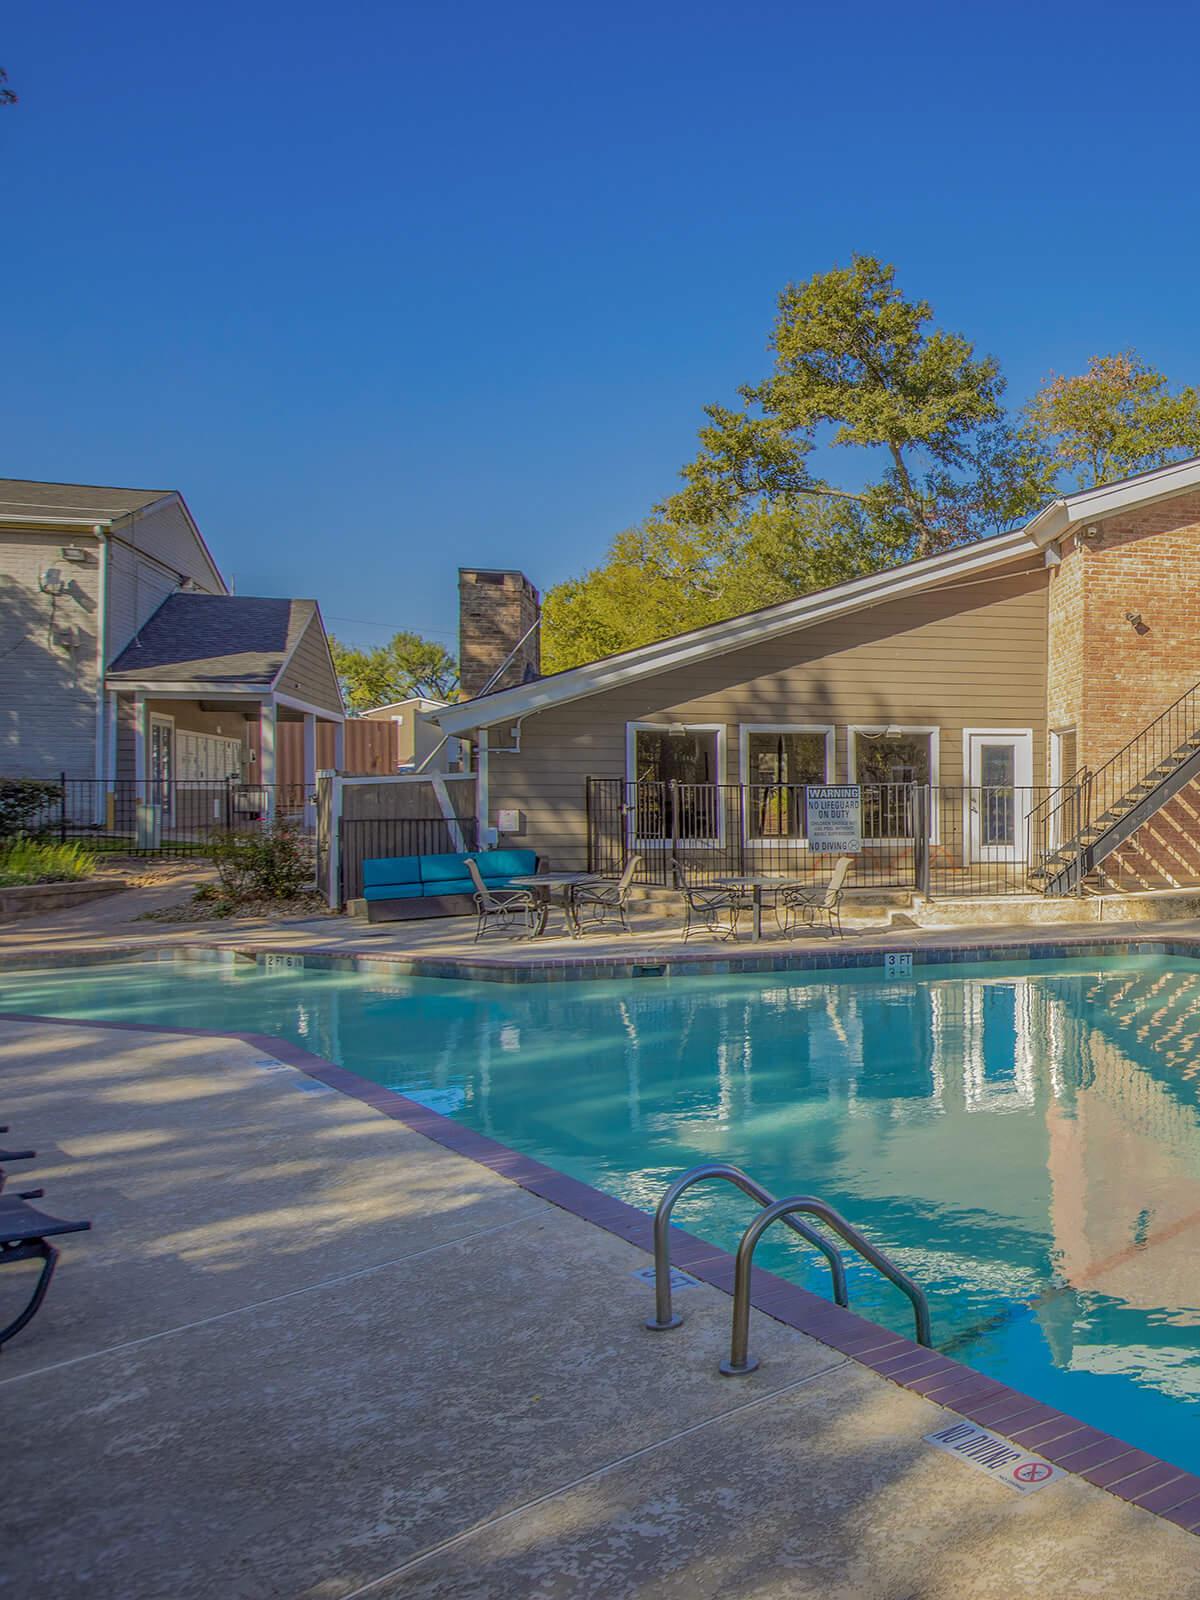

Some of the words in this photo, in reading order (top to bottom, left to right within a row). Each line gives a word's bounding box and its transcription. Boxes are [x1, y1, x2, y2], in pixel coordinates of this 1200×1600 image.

[809, 789, 859, 798] WARNING
[808, 801, 819, 809] NO
[821, 800, 859, 809] LIFEGUARD
[818, 810, 829, 818] ON
[831, 810, 850, 818] DUTY
[809, 841, 819, 851] NO
[821, 841, 847, 850] DIVING
[888, 955, 896, 965] 3
[899, 954, 912, 965] FT
[932, 1423, 976, 1444] NO
[953, 1435, 1022, 1470] DIVING
